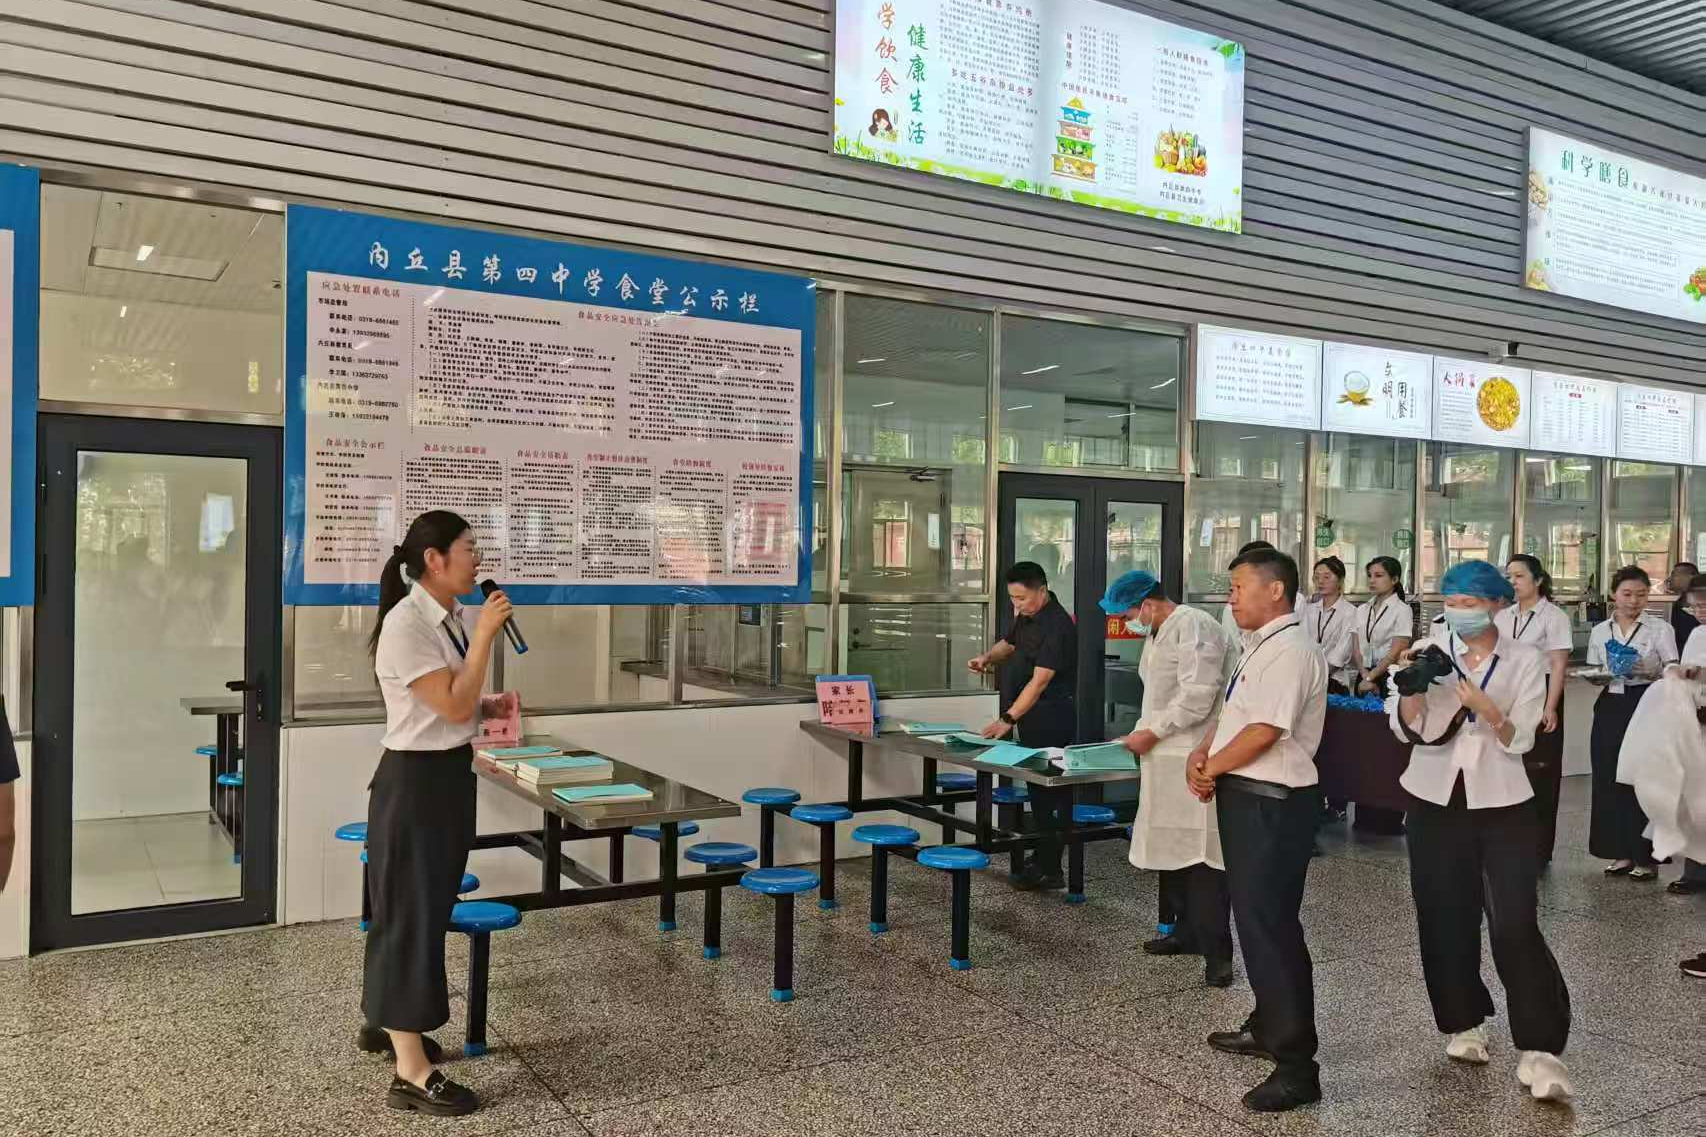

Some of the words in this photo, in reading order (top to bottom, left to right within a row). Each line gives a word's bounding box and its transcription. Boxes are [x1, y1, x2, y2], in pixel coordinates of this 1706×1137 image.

[874, 1, 898, 95] 学饮食
[906, 23, 929, 146] 健康生活
[1561, 149, 1629, 188] 科学膳食
[322, 281, 400, 298] 应急处置联系电话
[367, 241, 761, 313] 内丘县第四中学食堂公示栏
[1382, 361, 1393, 399] 文明
[831, 685, 855, 696] 家长
